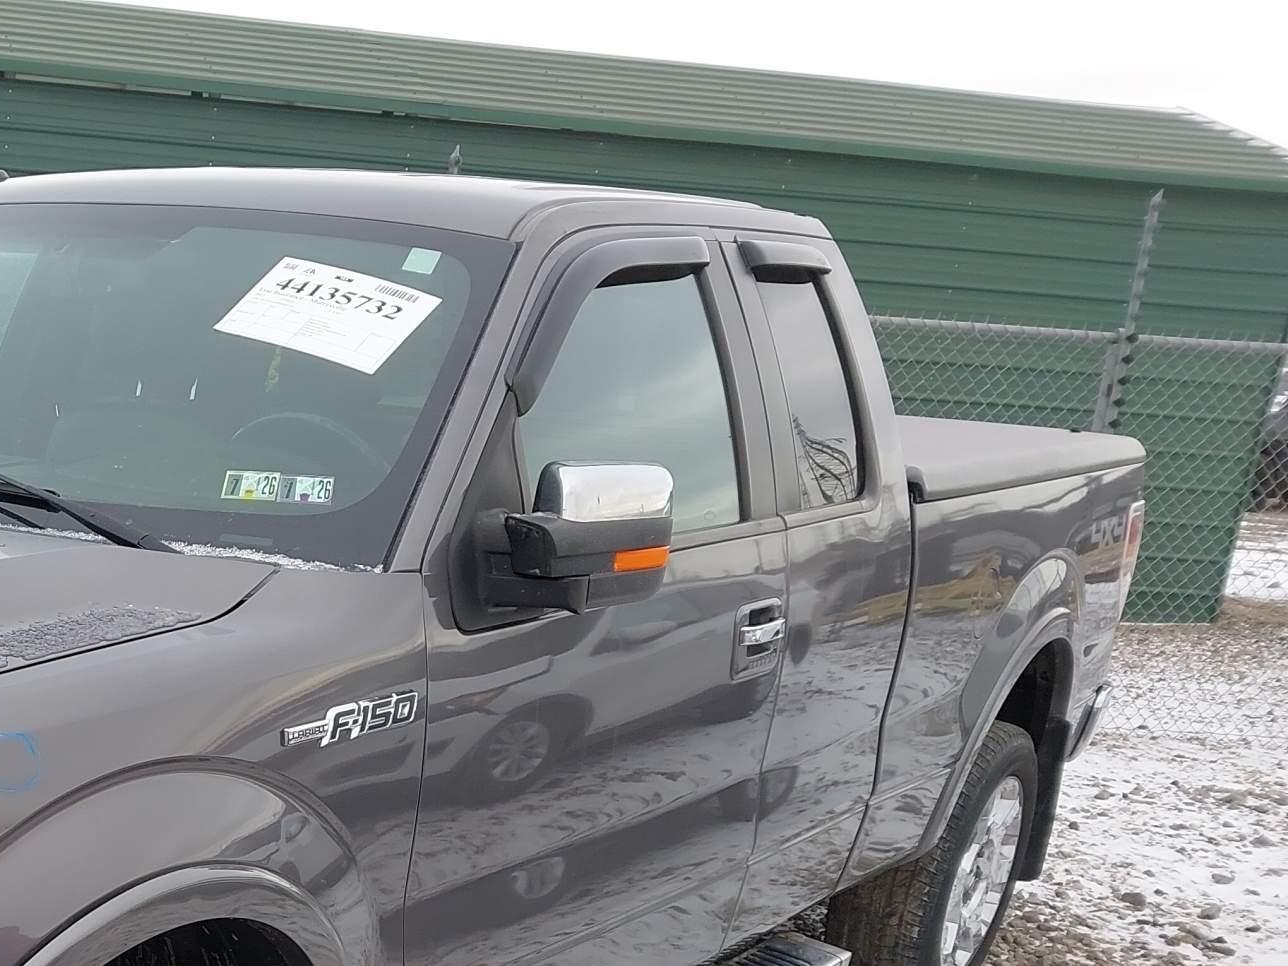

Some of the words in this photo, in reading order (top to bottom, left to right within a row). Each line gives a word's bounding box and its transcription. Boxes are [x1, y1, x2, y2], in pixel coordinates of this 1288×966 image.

[275, 278, 403, 320] 44135732
[262, 475, 277, 496] 26
[317, 480, 332, 500] 26
[321, 692, 418, 748] F-150
